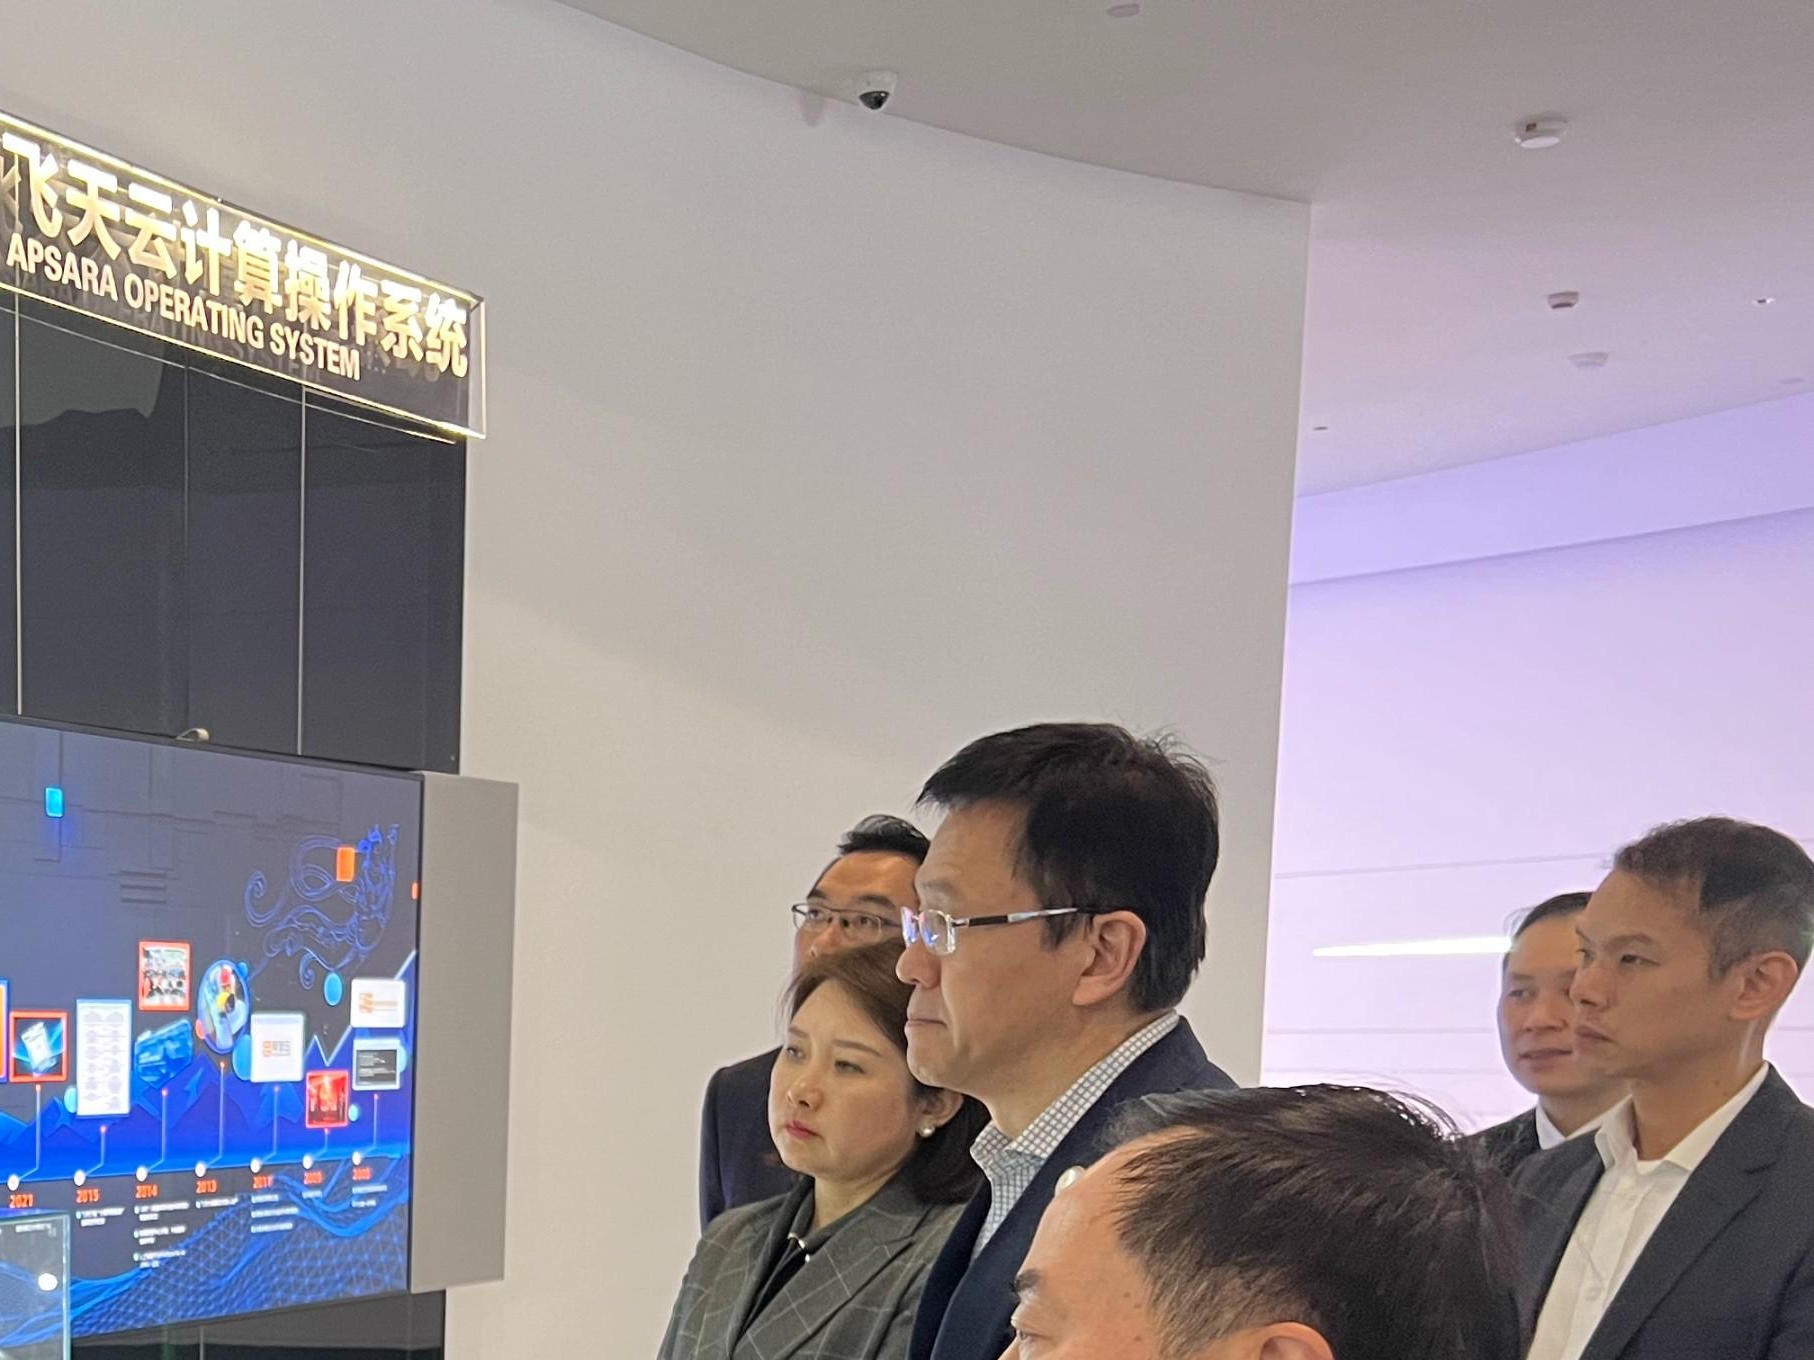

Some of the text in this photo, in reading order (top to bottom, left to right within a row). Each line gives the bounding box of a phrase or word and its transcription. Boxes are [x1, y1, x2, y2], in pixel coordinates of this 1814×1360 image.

[2, 132, 469, 377] 飞天云计算操作系统
[6, 233, 361, 381] APSARA OPERATING SYSTEM
